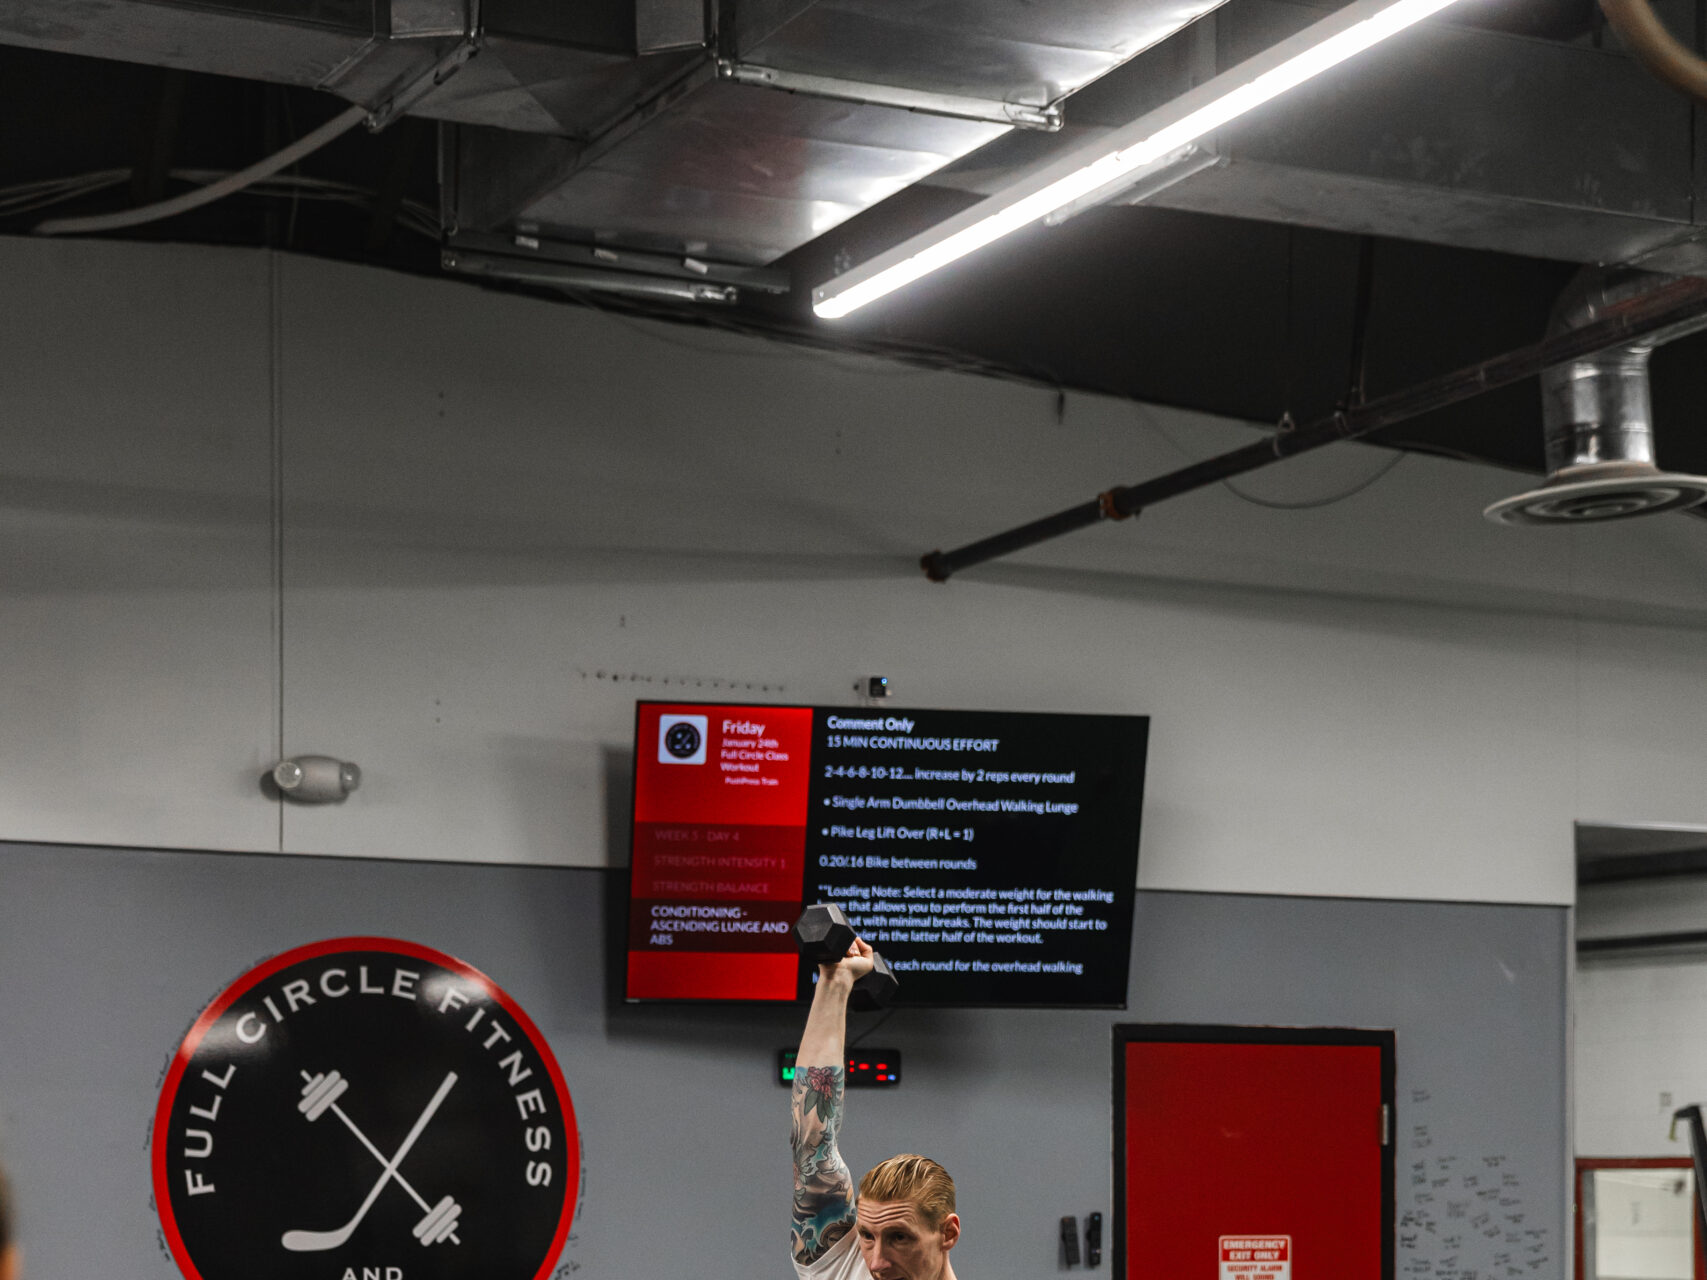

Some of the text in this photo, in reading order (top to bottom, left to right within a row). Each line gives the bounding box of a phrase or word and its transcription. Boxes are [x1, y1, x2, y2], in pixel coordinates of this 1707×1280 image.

[722, 720, 765, 737] Friday
[827, 715, 914, 734] Comment Only
[722, 738, 756, 750] January
[827, 735, 1000, 752] 15 MIN CONTINUOUS EFFORT
[721, 750, 789, 761] Full Circle Class
[720, 762, 759, 772] Workout
[961, 768, 975, 783] by
[976, 769, 985, 782] 2
[985, 771, 1009, 784] reps
[1010, 772, 1041, 785] every
[1042, 771, 1076, 783] round
[832, 795, 1079, 815] Single Arm Dumbbell Overhead Walking Lunge
[706, 831, 730, 841] DAY
[830, 825, 854, 838] Pike
[856, 826, 875, 840] Leg
[876, 826, 895, 839] Lift
[897, 826, 925, 839] Over
[718, 856, 776, 868] INTENSITY
[865, 856, 890, 868] Bike
[891, 856, 938, 869] between
[939, 857, 977, 870] rounds
[716, 882, 769, 893] BALANCE
[872, 886, 901, 898] Note:
[903, 886, 936, 898] Select
[937, 889, 945, 898] a
[946, 887, 997, 899] moderate
[998, 887, 1035, 902] weight
[1036, 888, 1052, 900] for
[1053, 888, 1071, 900] the
[1073, 889, 1114, 903] walking
[651, 906, 741, 918] CONDITIONING
[848, 900, 870, 911] that
[872, 901, 906, 912] allows
[907, 903, 928, 914] you
[929, 902, 942, 912] to
[943, 902, 987, 915] perform
[988, 902, 1005, 914] the
[1007, 902, 1029, 914] first
[1031, 903, 1051, 914] half
[1052, 903, 1064, 915] of
[1065, 903, 1084, 915] the
[651, 920, 789, 934] ASCENDING LUNGE AND
[863, 916, 887, 926] with
[888, 916, 931, 927] minimal
[973, 916, 993, 928] The
[994, 917, 1031, 931] weight
[1032, 917, 1067, 930] should
[1068, 918, 1093, 930] start
[1095, 919, 1108, 930] to
[650, 933, 673, 945] ABS
[879, 931, 889, 942] in
[890, 931, 909, 942] the
[910, 931, 940, 943] latter
[942, 931, 963, 943] half
[963, 932, 976, 943] of
[977, 932, 994, 943] the
[894, 959, 919, 971] each
[920, 959, 953, 971] round
[954, 960, 970, 971] for
[972, 960, 990, 972] the
[991, 961, 1041, 972] overhead
[1042, 961, 1083, 975] walking
[184, 965, 553, 1196] FULL CIRCLE FITNESS
[1223, 1239, 1286, 1250] EMERGENCY
[1229, 1250, 1280, 1260] EXIT ONLY
